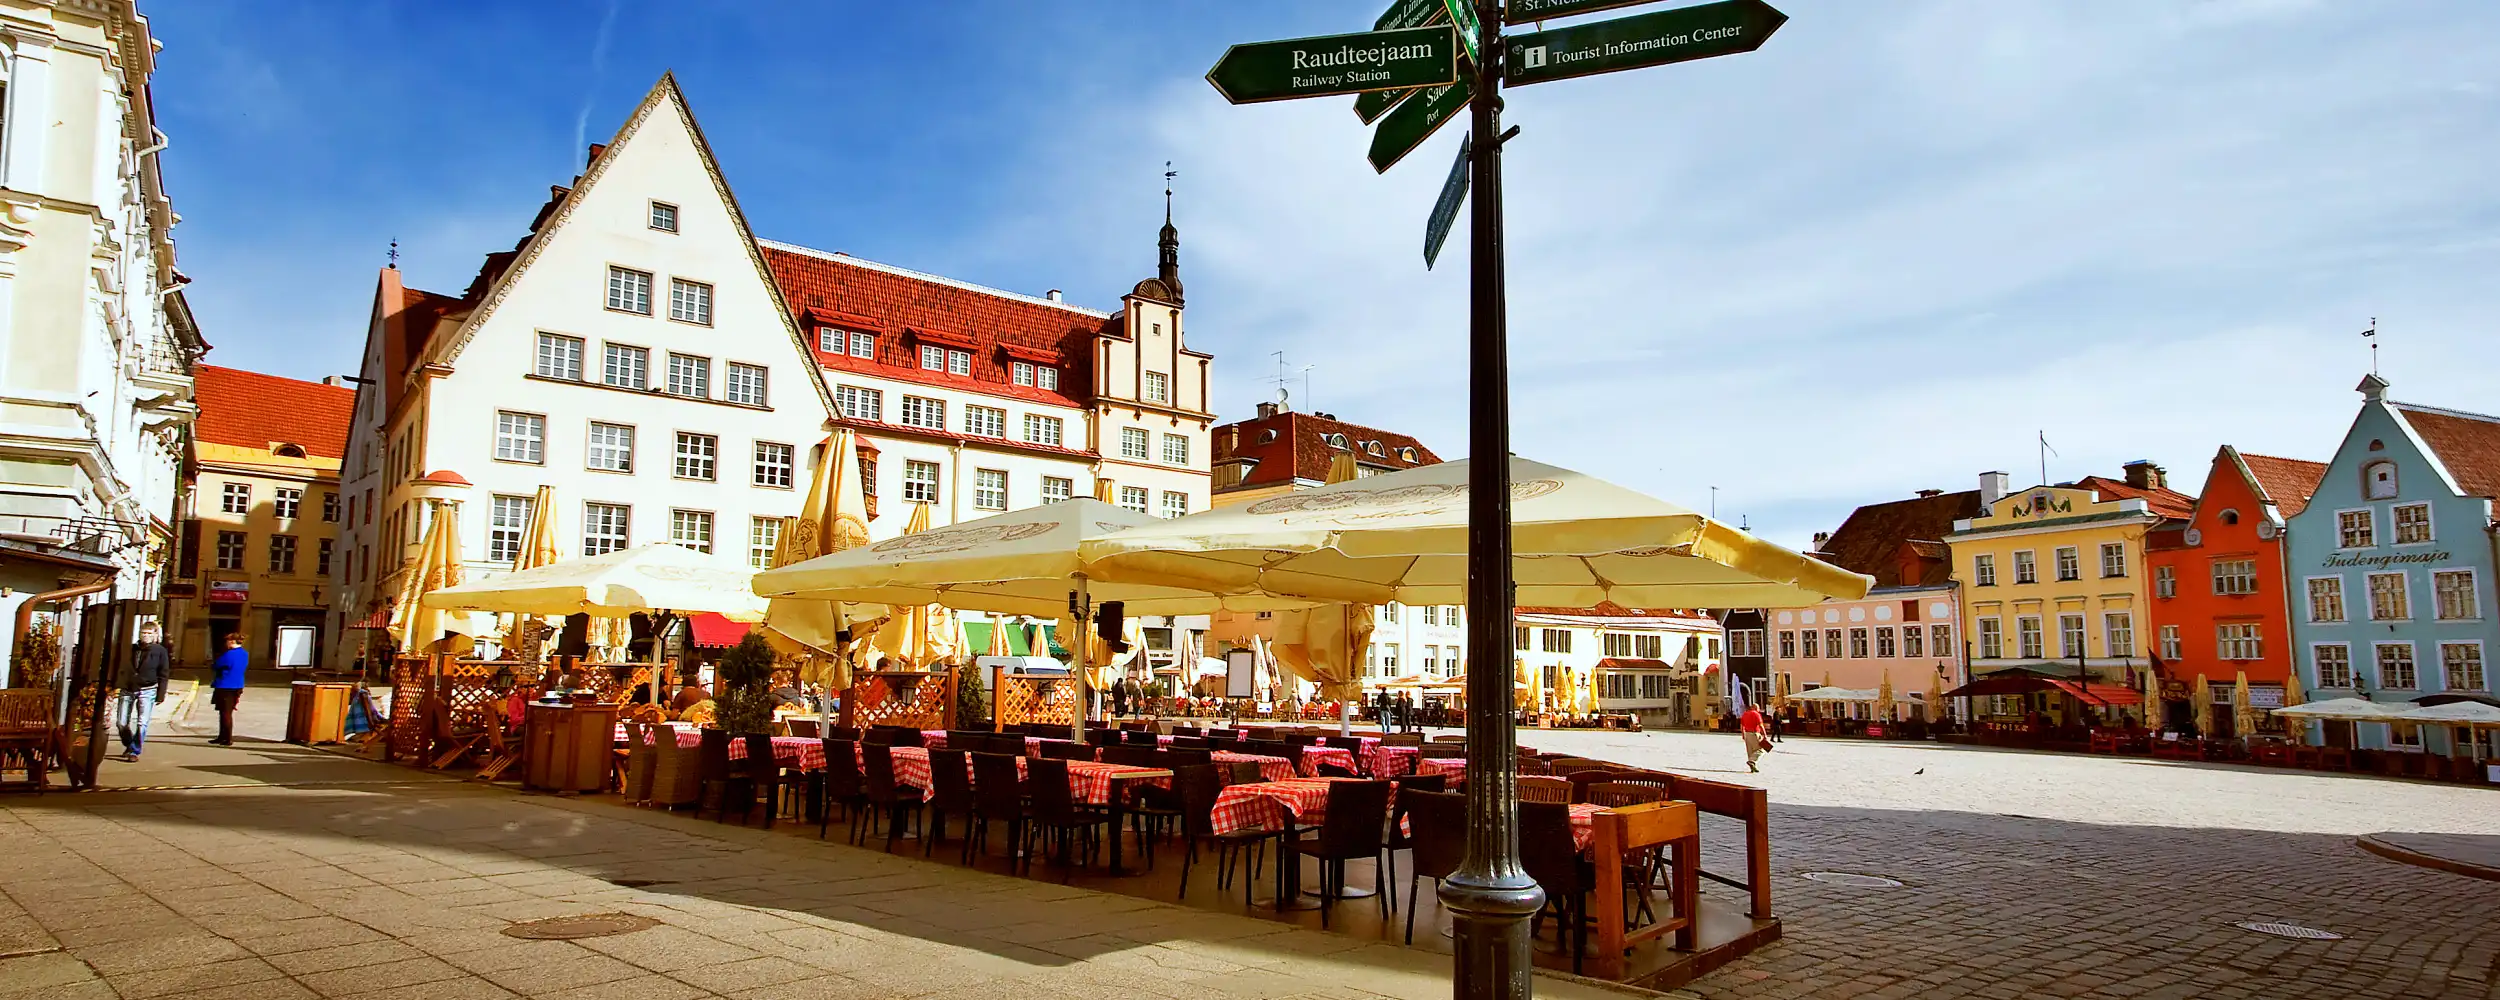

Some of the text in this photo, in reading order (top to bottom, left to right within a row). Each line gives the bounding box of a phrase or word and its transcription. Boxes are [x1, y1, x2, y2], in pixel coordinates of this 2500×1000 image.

[1525, 0, 1543, 11] St.
[1552, 47, 1601, 65] Tourist
[1605, 35, 1688, 56] Information
[1692, 25, 1743, 43] Center
[1292, 41, 1433, 70] Raudteejaam
[1292, 69, 1390, 88] Railway Station
[1426, 108, 1440, 125] Port
[2322, 550, 2450, 570] Tudengimaja
